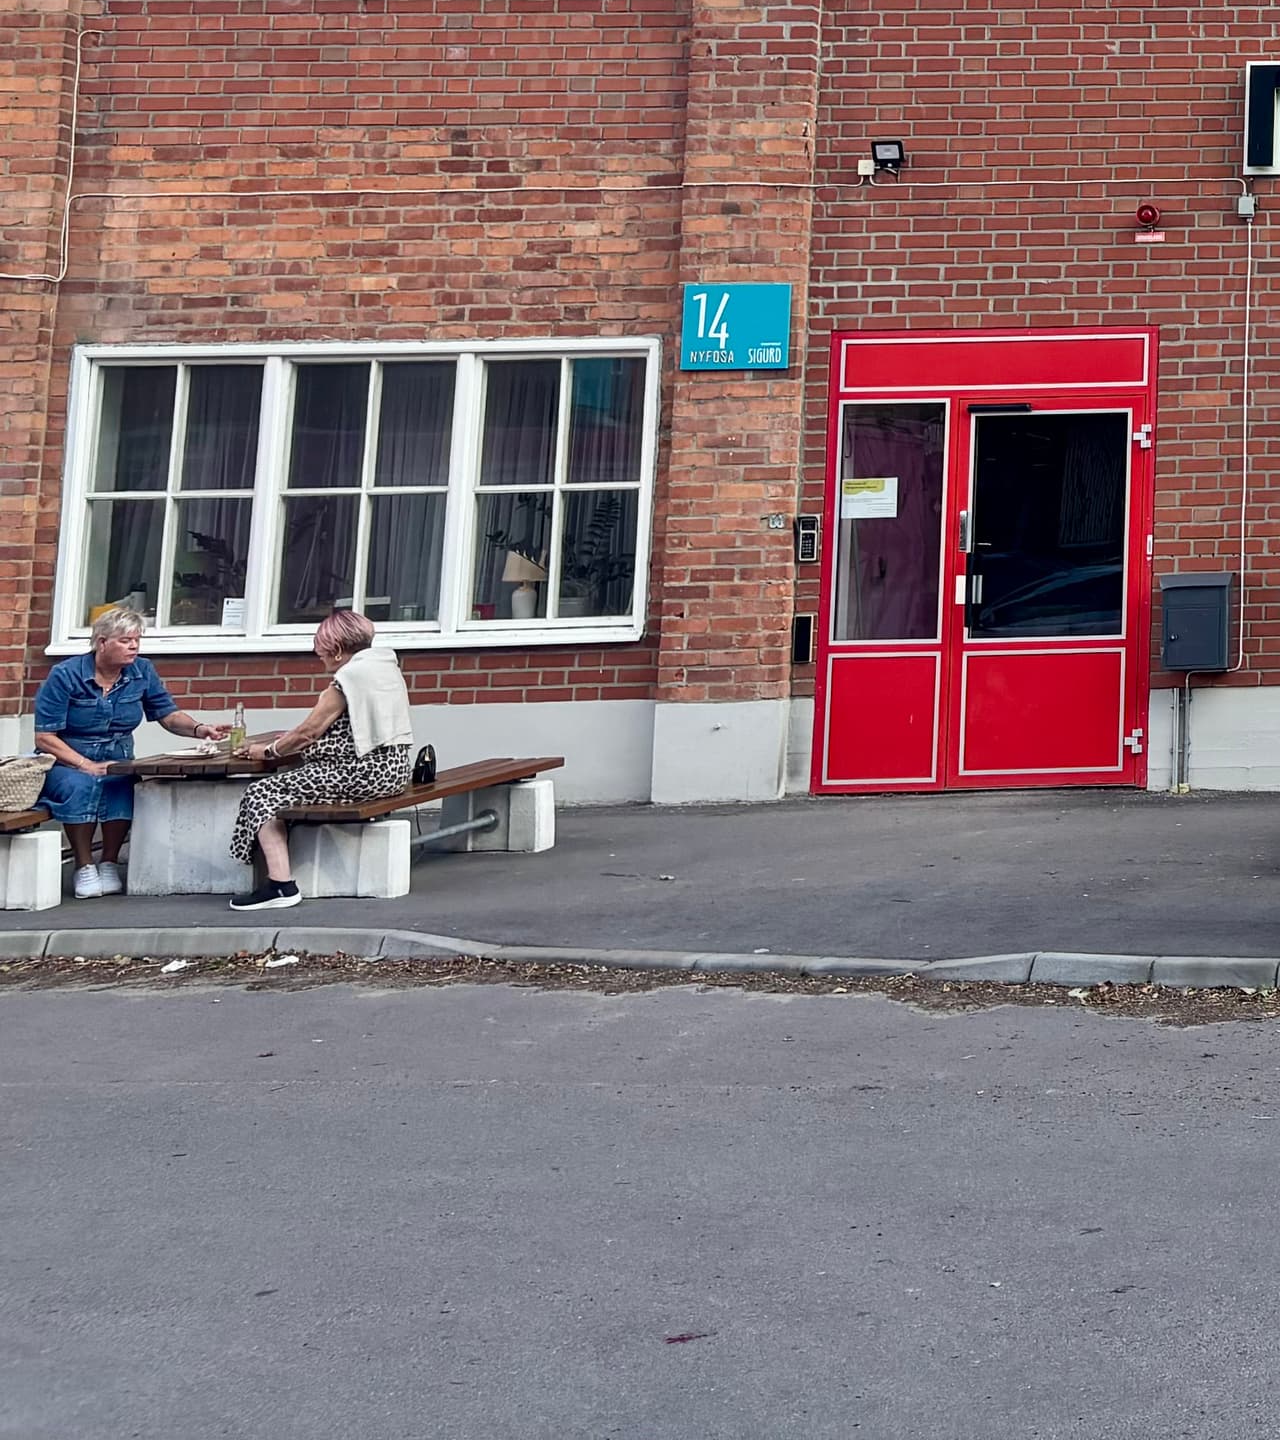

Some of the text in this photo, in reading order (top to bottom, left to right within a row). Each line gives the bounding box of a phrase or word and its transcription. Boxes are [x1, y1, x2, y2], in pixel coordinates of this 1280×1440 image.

[693, 292, 729, 349] 14
[690, 350, 734, 363] NYFOSA
[748, 347, 782, 363] SIGURD
